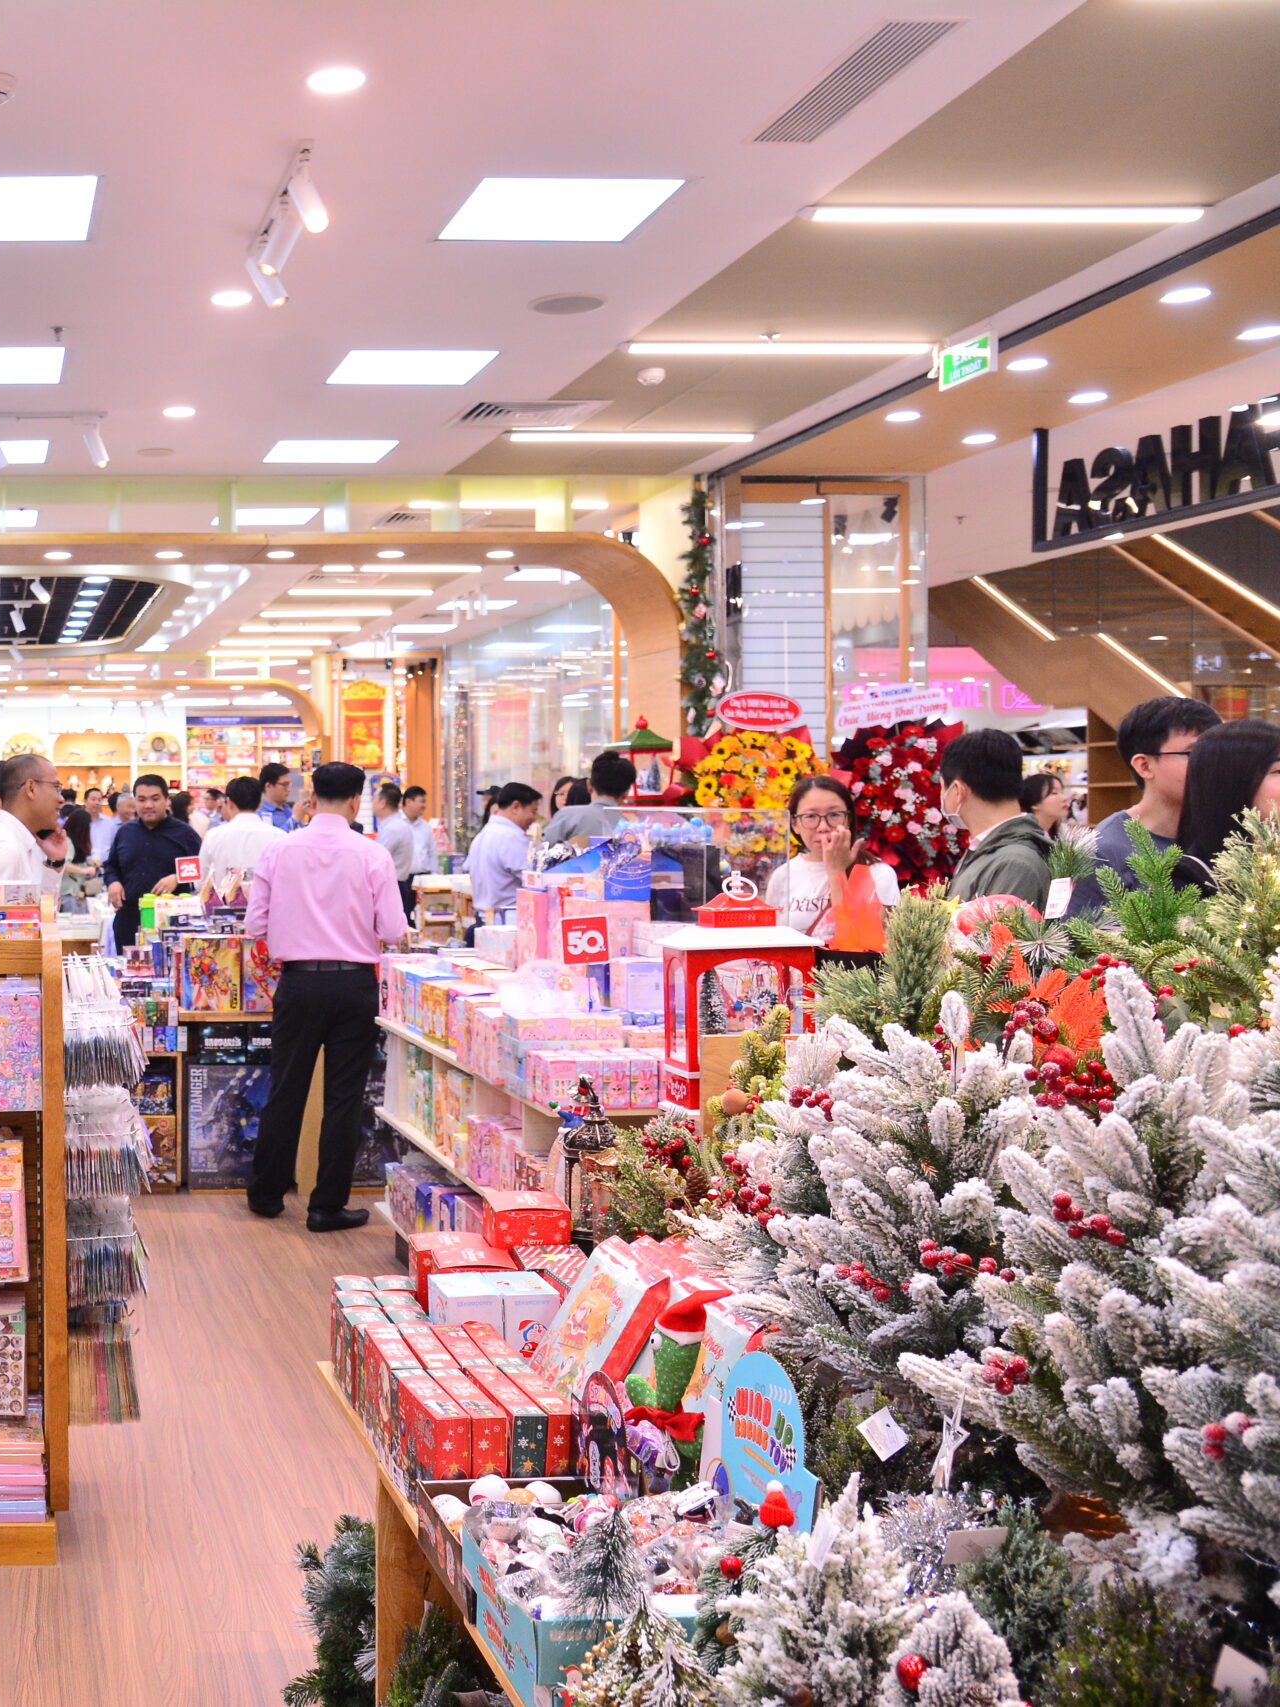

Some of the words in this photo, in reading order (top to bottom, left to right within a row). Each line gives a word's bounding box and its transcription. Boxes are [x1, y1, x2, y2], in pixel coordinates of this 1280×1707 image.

[190, 1068, 203, 1112] DANGER
[522, 1238, 544, 1246] Merry
[734, 1417, 769, 1452] RACING
[735, 1387, 772, 1428] WIND
[774, 1409, 794, 1450] UP
